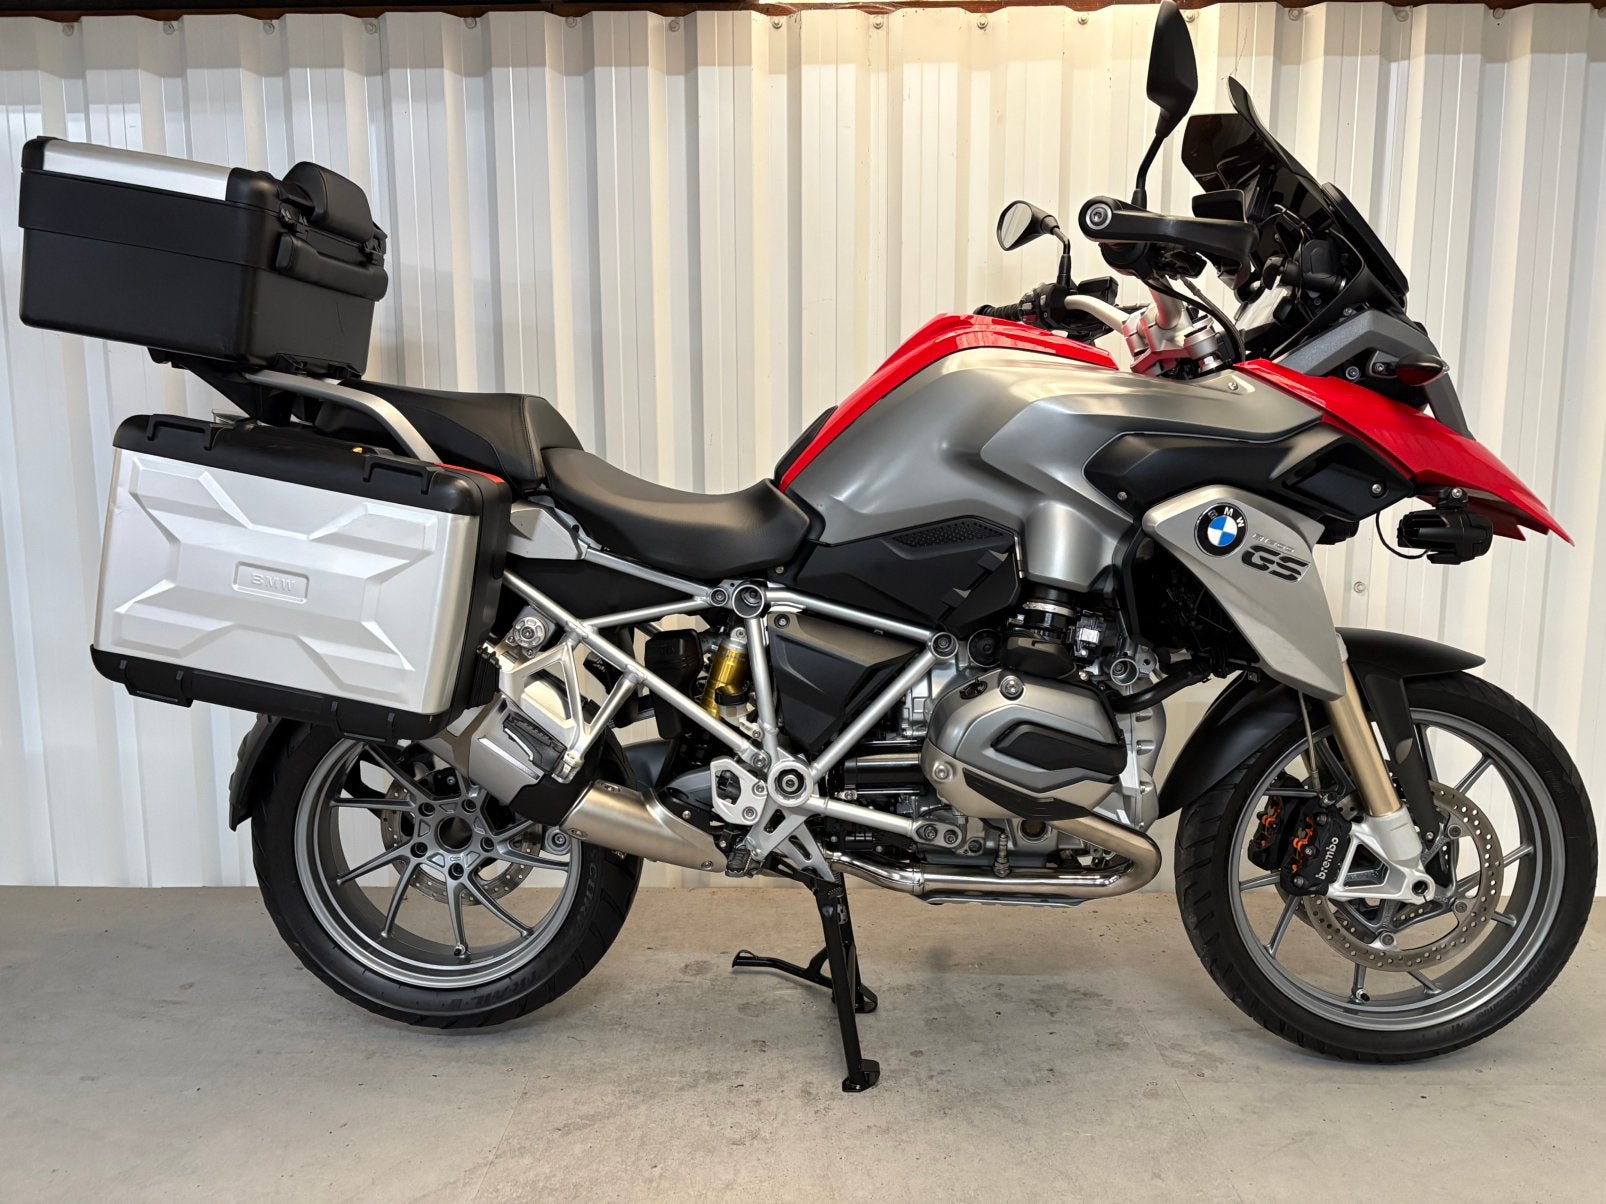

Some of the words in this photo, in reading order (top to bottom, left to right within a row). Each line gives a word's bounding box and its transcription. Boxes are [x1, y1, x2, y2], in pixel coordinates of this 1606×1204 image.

[1207, 506, 1245, 529] BMW
[1241, 545, 1311, 583] GS
[251, 573, 297, 591] BMW
[1315, 836, 1339, 880] brembo
